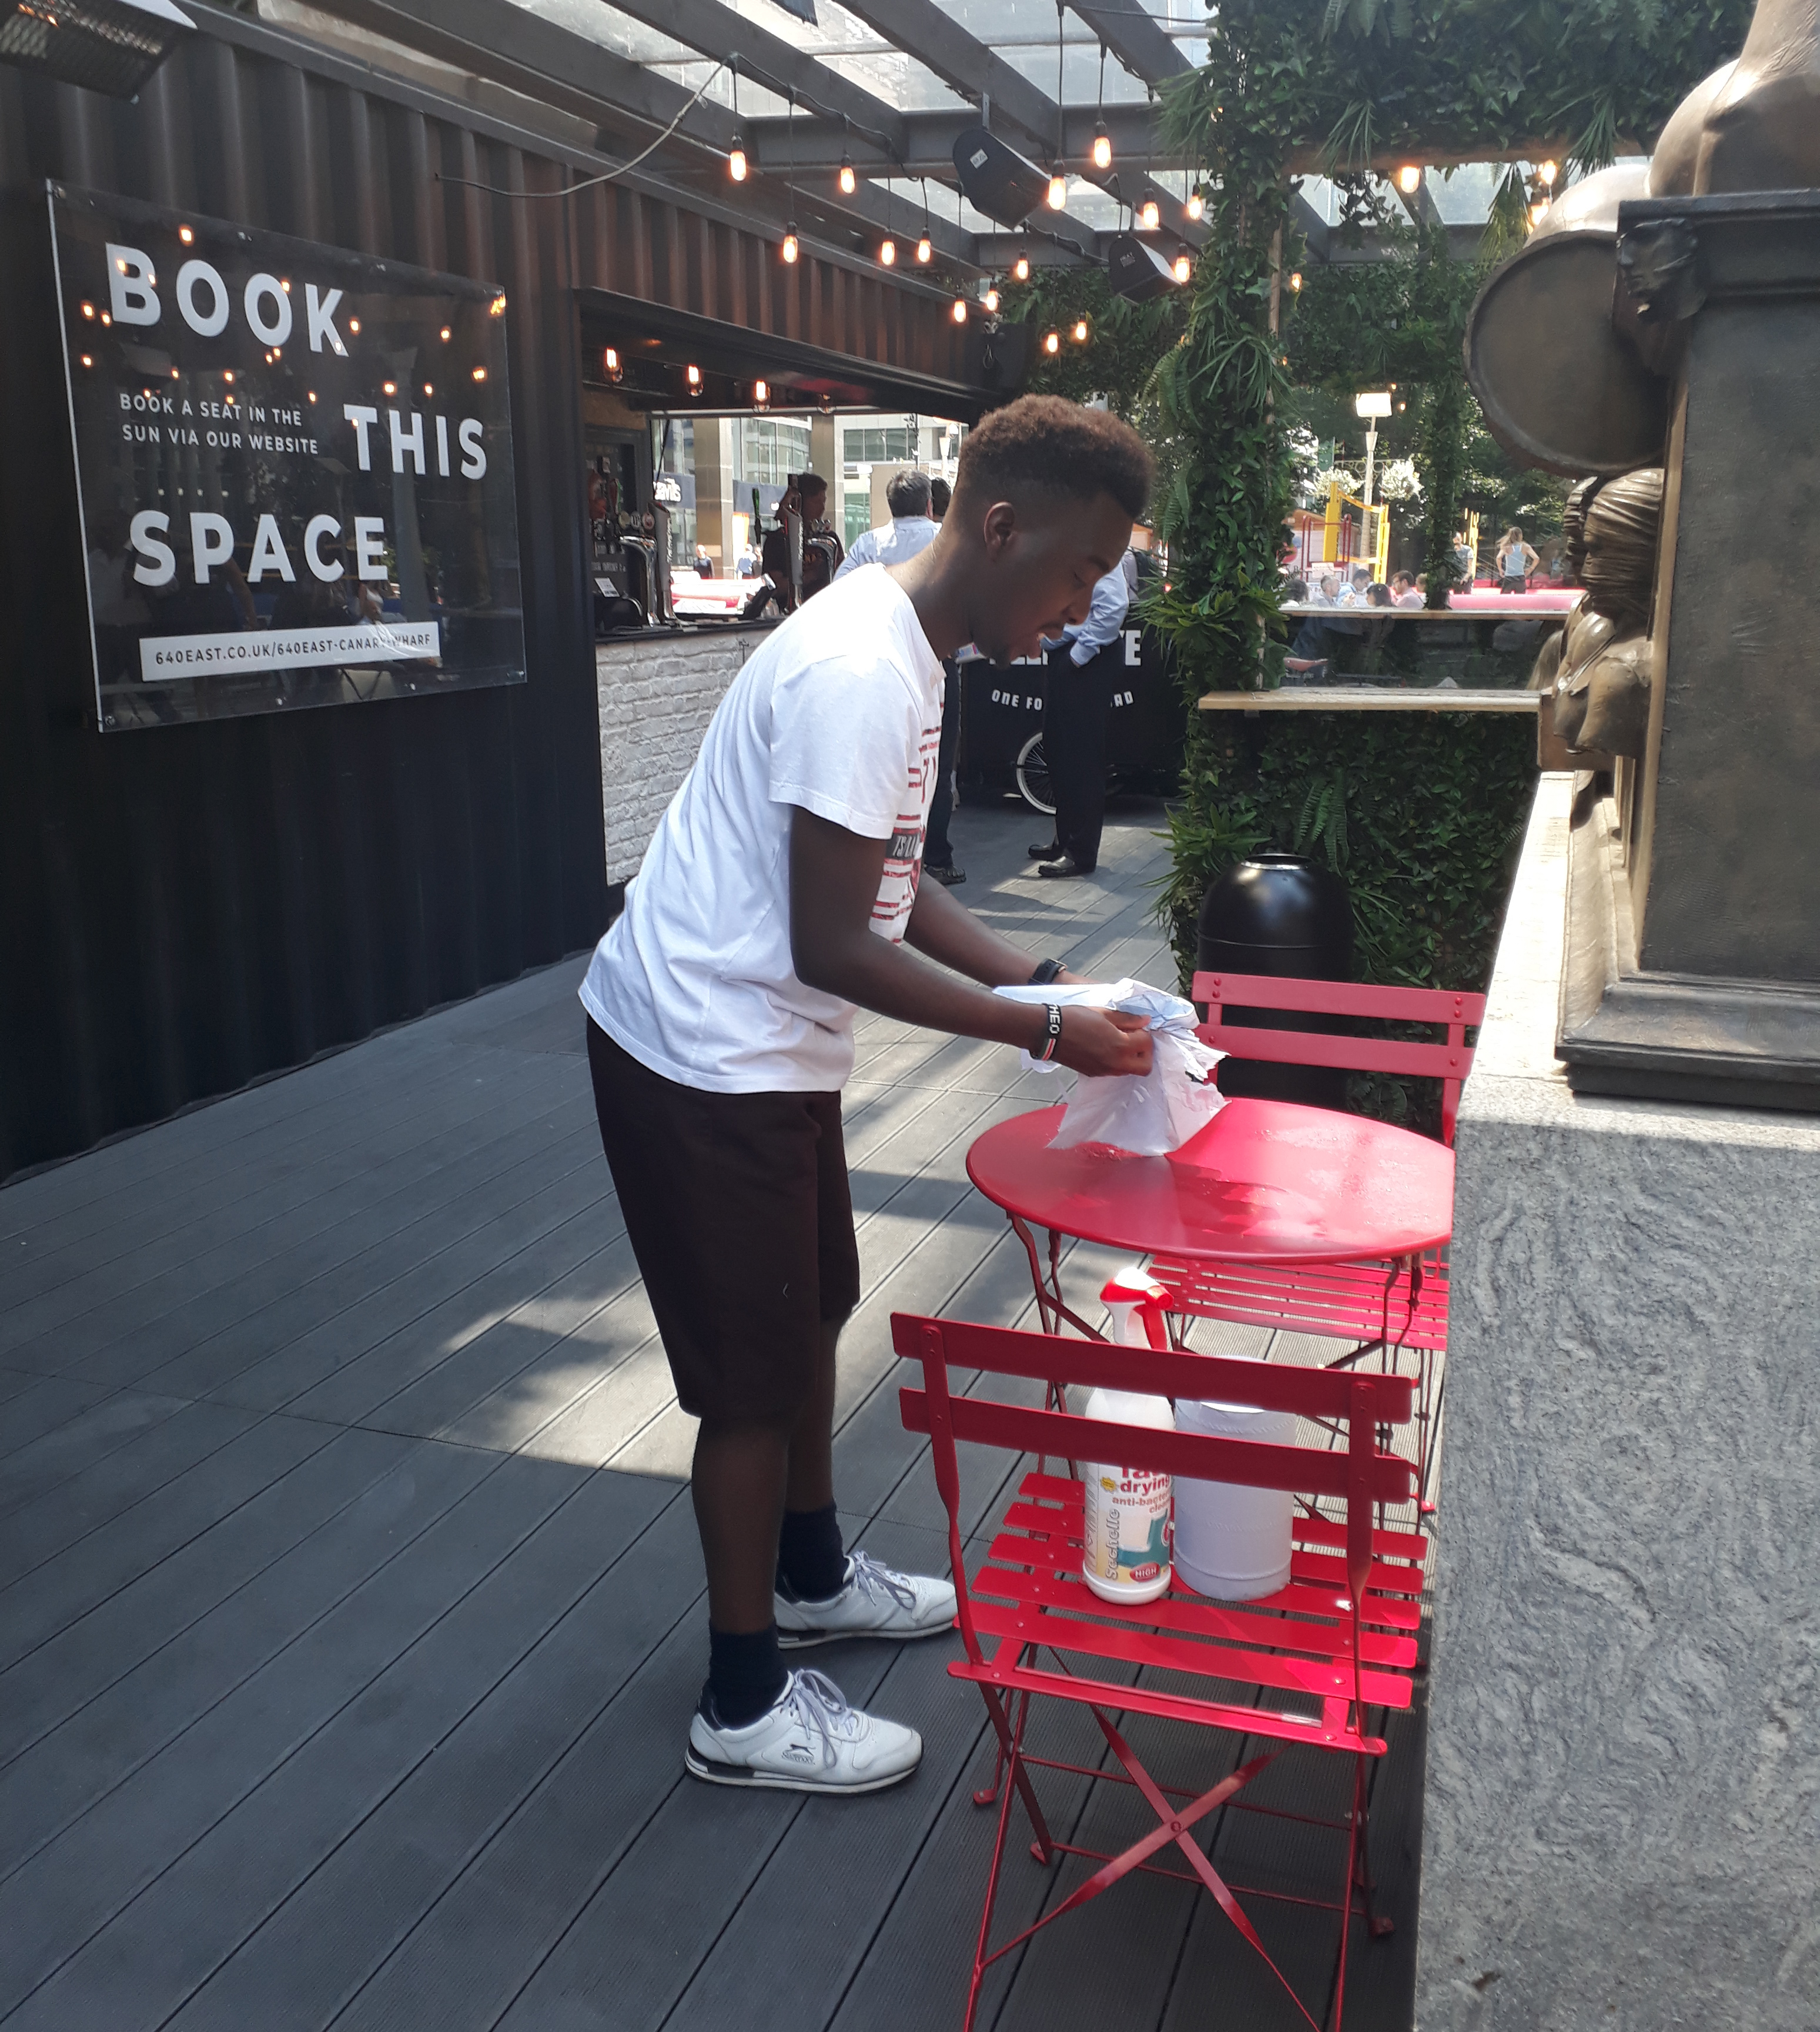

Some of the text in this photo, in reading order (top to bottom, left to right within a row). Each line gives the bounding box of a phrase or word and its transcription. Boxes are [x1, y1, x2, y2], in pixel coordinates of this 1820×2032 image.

[106, 242, 349, 357] BOOK
[120, 393, 302, 426] BOOK A SEAT IN THE
[122, 425, 319, 455] SUN VIA OUR WEBSITE
[343, 404, 487, 480] THIS
[130, 510, 388, 586] SPACE
[1026, 697, 1043, 711] FO
[1110, 691, 1134, 708] AD
[1120, 1475, 1170, 1496] drying
